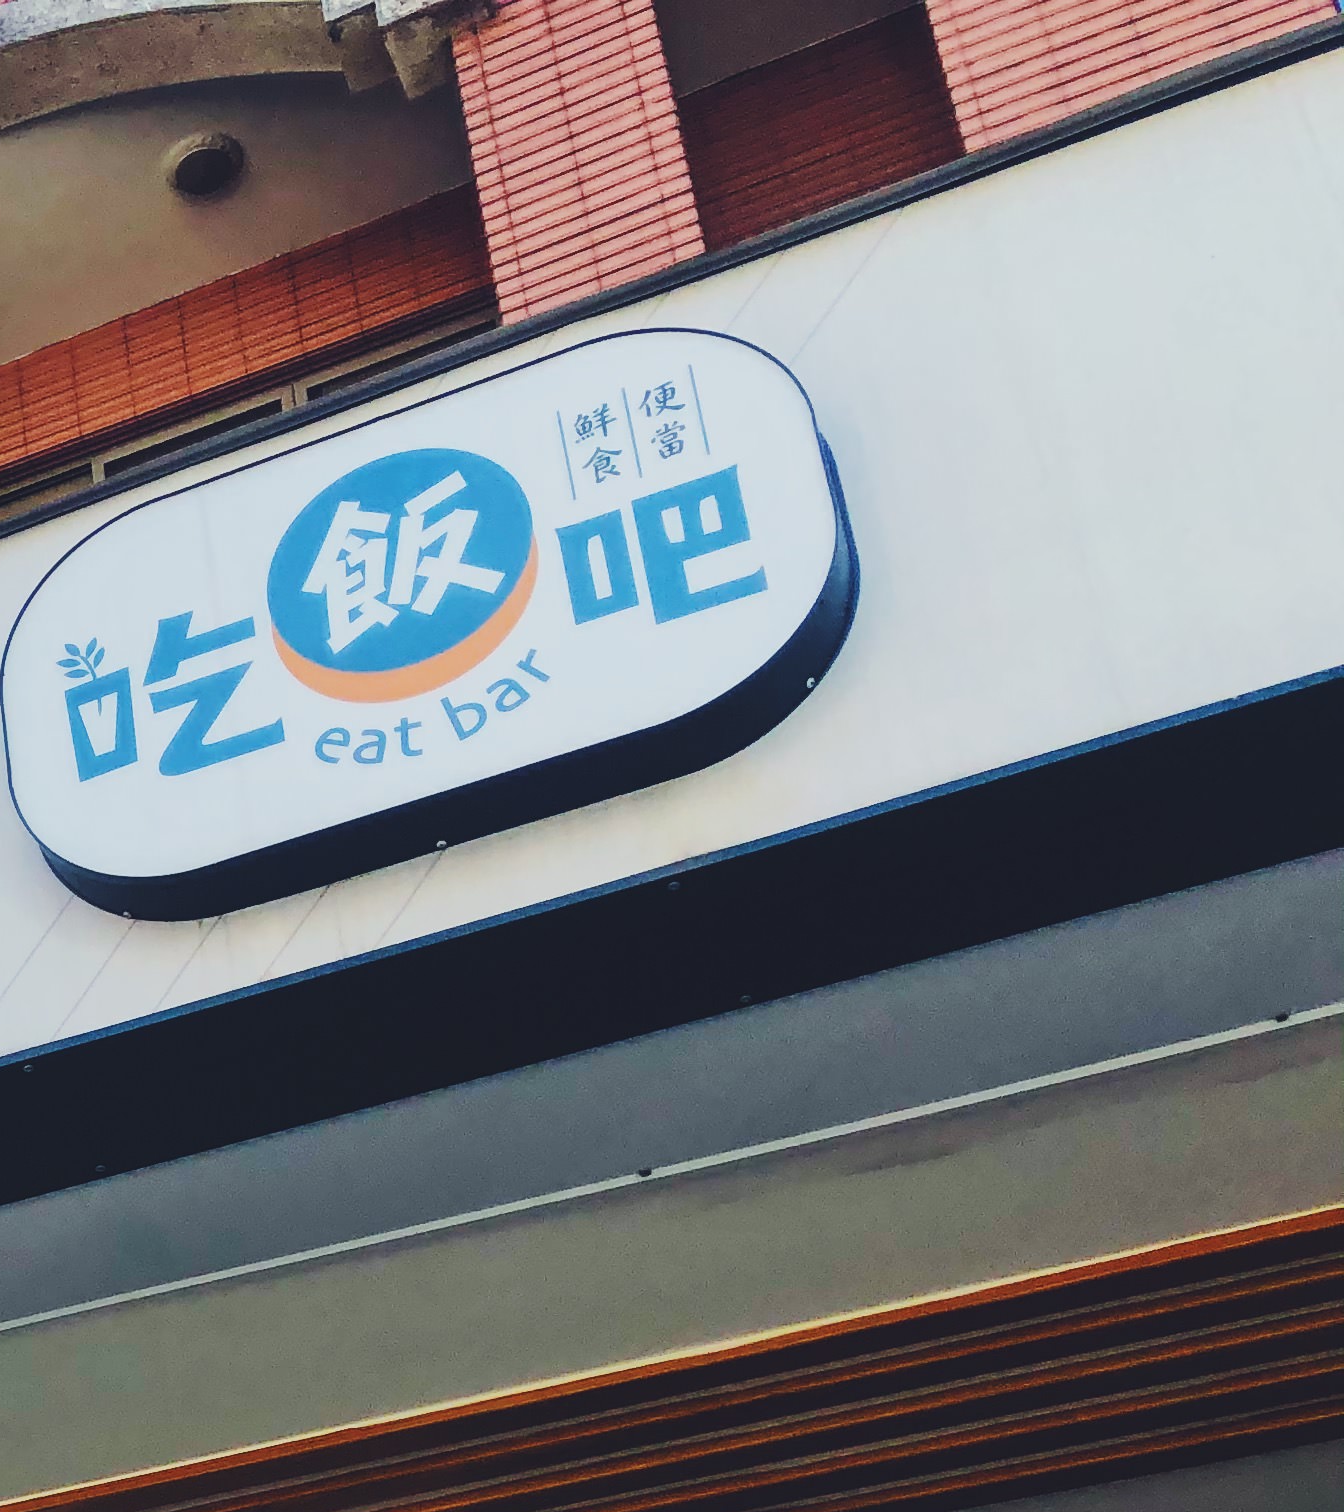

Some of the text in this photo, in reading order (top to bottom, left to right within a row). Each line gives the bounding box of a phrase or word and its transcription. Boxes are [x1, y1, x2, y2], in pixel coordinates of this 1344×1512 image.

[574, 403, 623, 484] 鮮食
[639, 380, 686, 460] 便當
[313, 648, 552, 766] eat bar
